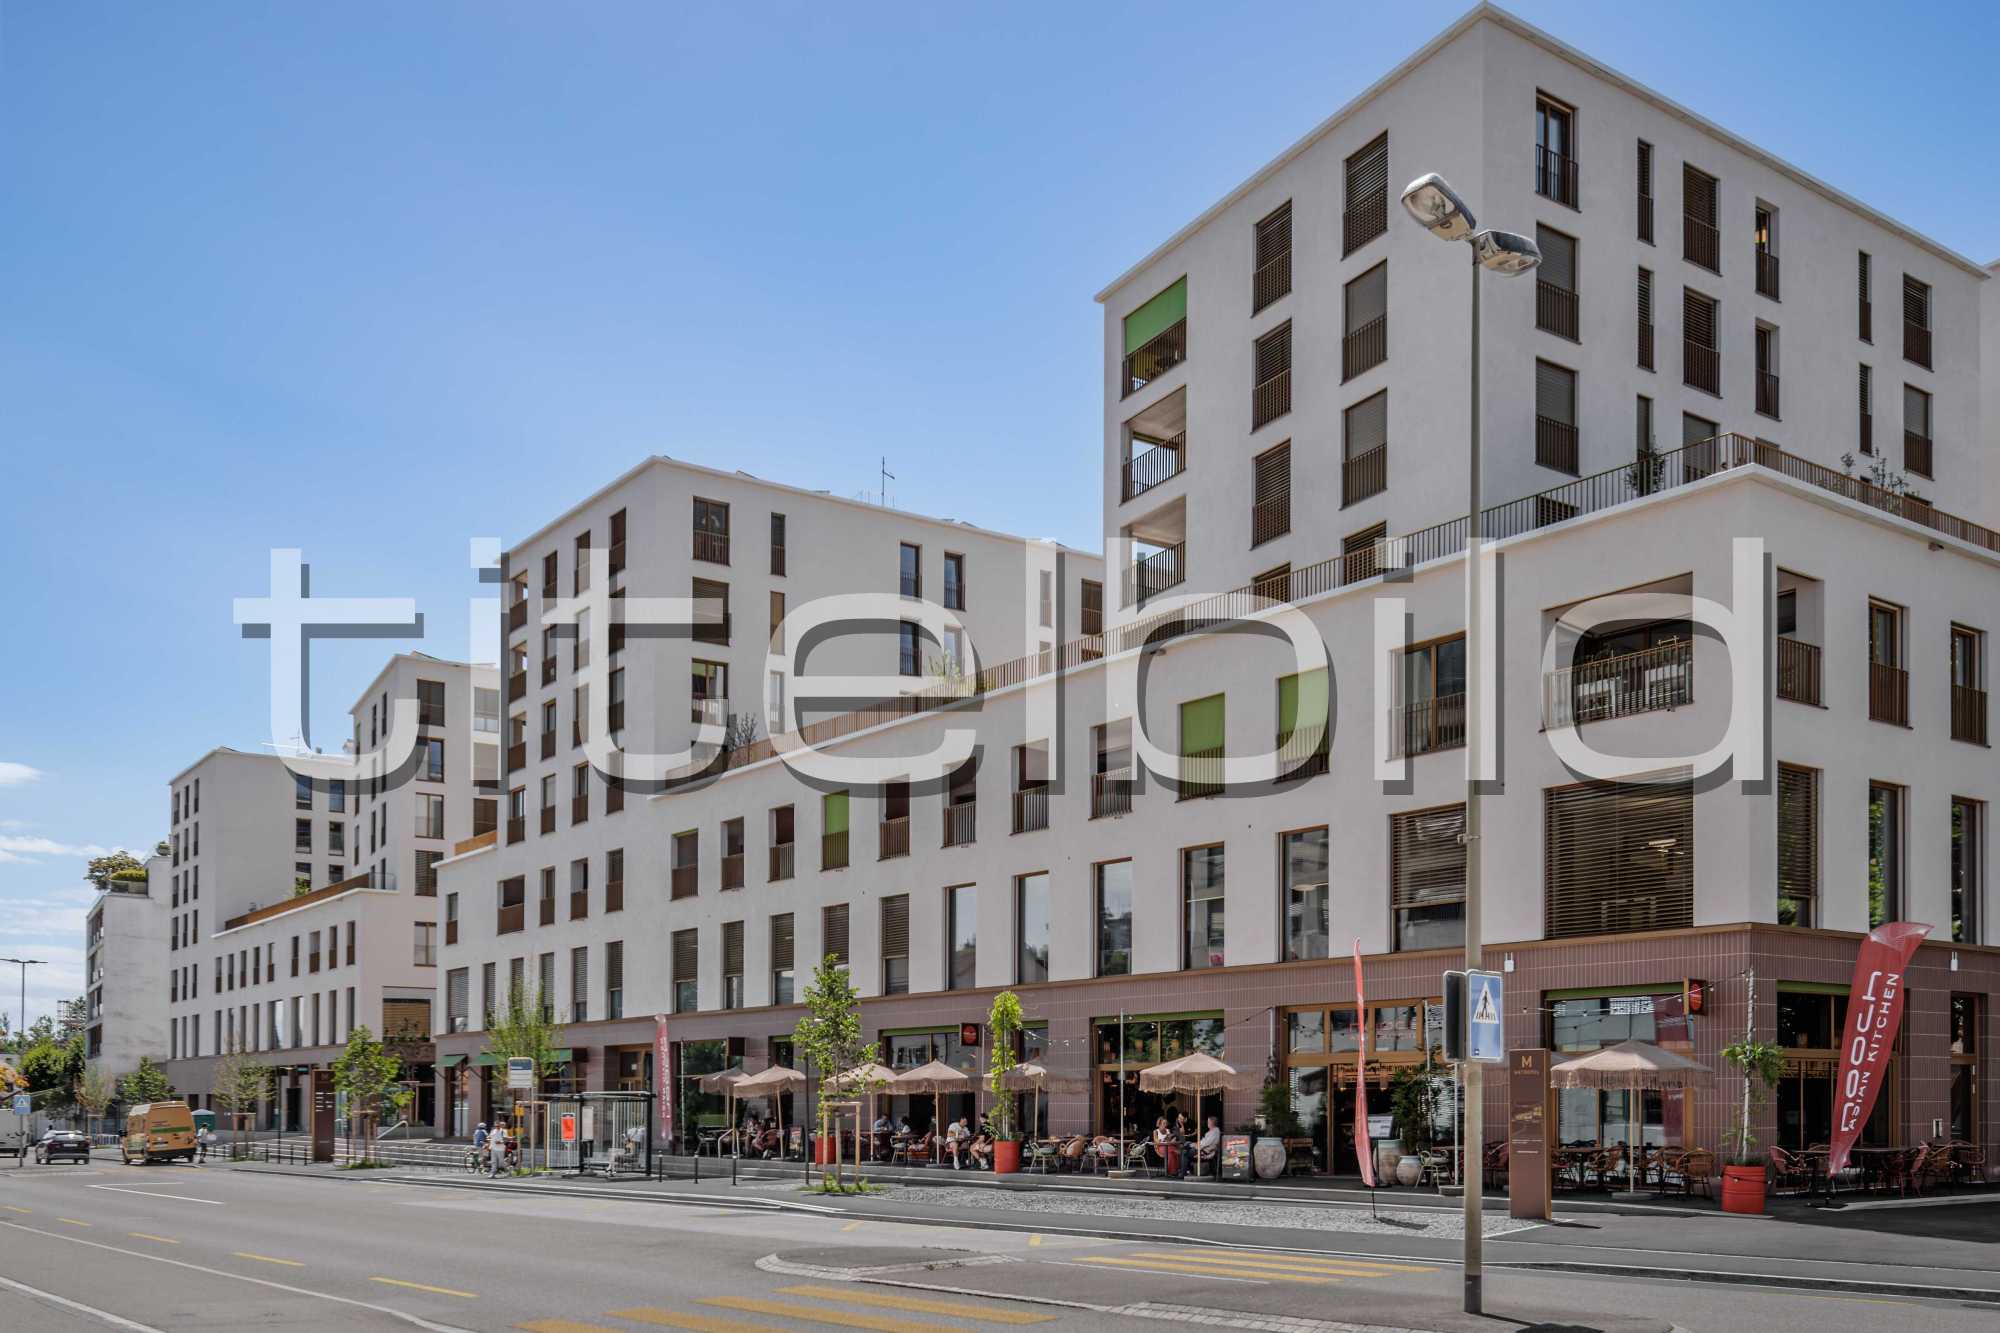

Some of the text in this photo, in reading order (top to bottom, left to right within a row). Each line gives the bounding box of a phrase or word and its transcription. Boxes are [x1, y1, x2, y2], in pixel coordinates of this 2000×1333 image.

[1521, 1055, 1532, 1068] M
[1848, 972, 1900, 1131] ASIAN KITCHEN
